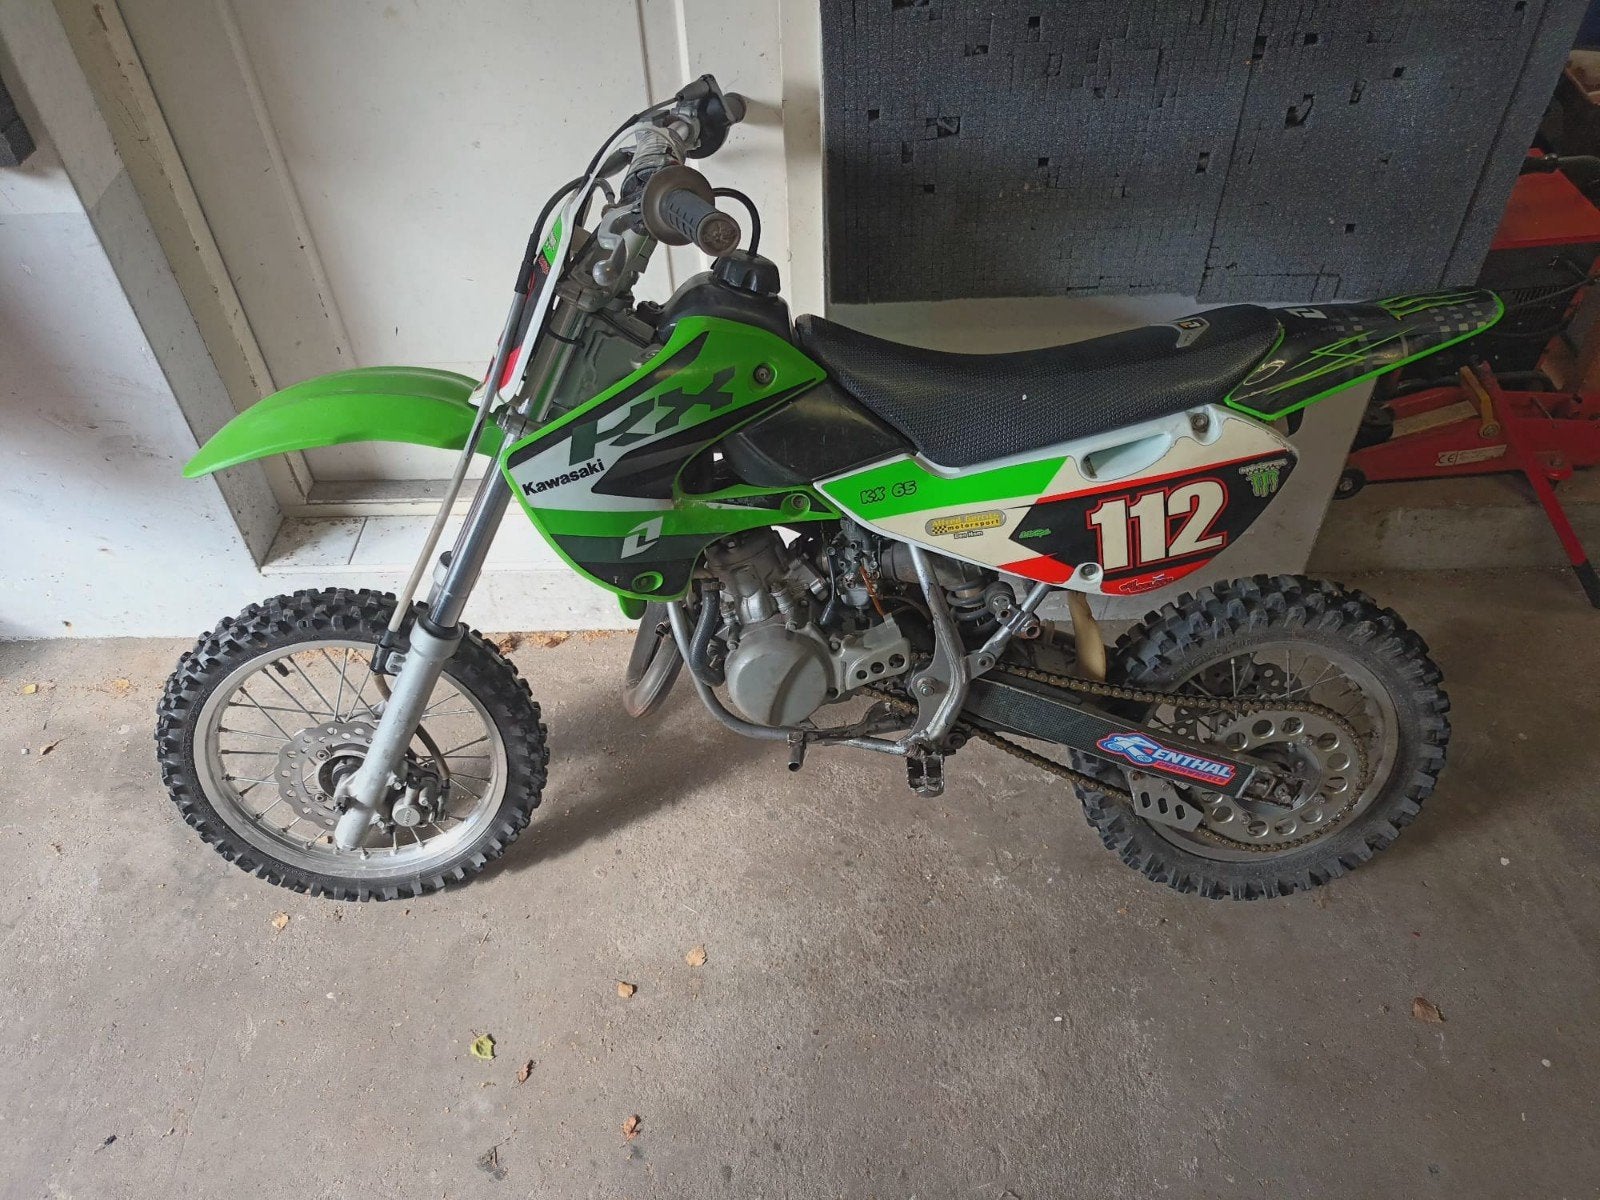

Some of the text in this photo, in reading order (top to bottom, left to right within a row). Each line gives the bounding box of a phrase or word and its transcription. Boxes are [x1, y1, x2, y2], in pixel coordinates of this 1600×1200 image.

[521, 458, 605, 496] Kawasaki
[860, 480, 917, 504] KX 65
[947, 519, 999, 531] motorsport
[1087, 478, 1229, 572] 112
